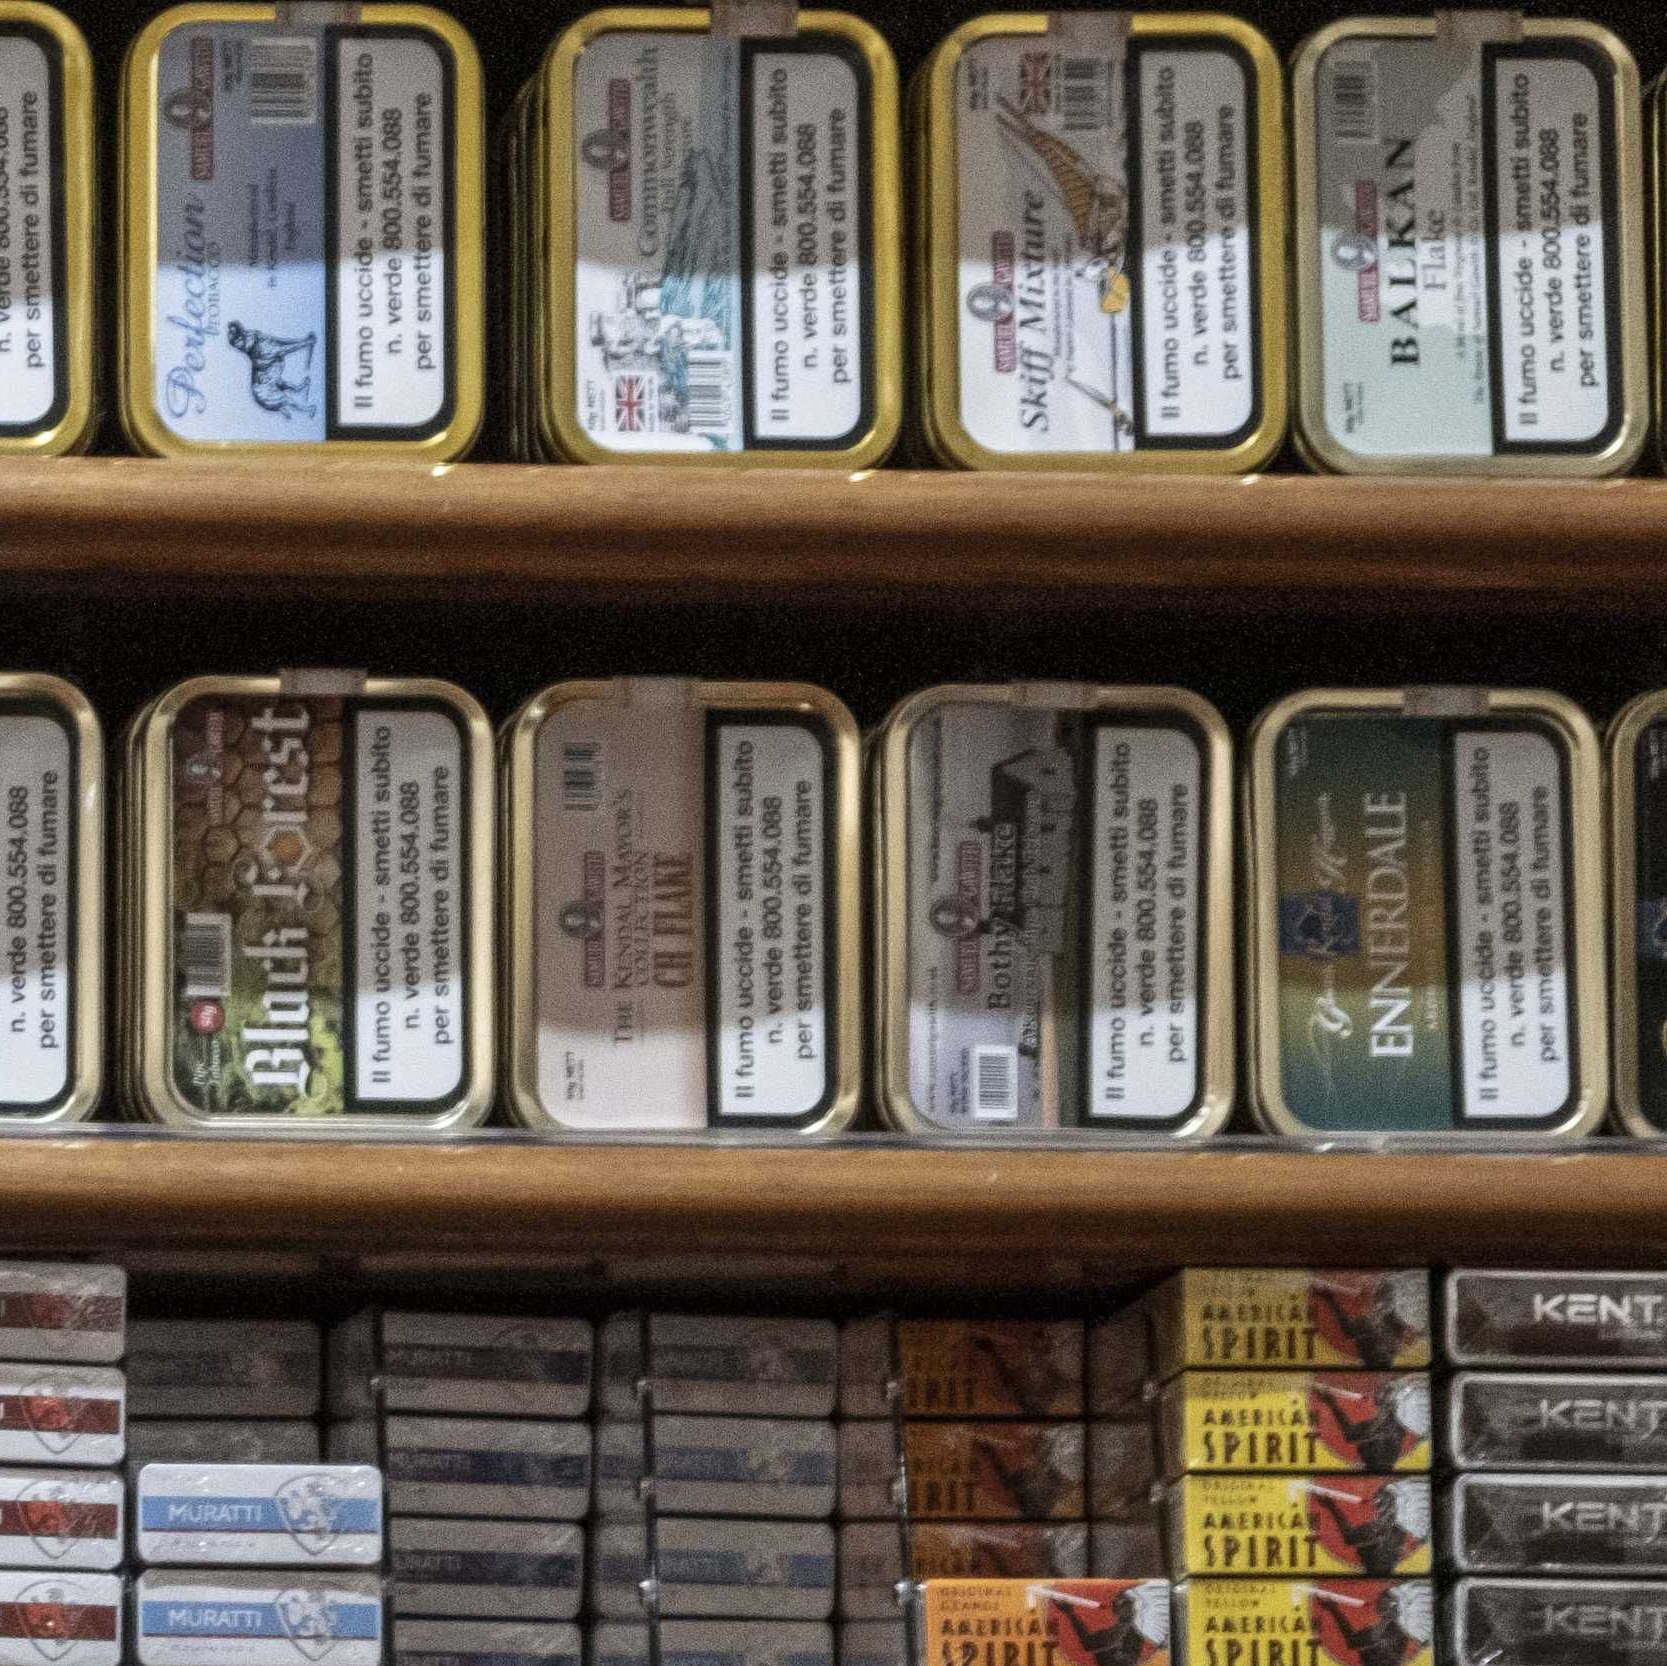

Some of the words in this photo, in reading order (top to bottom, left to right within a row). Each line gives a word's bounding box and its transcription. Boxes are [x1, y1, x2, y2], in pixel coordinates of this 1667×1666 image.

[1016, 189, 1049, 332] Mixture
[1389, 135, 1419, 369] BALKAN
[1421, 208, 1447, 292] Flake
[165, 197, 209, 419] Perfection
[1019, 341, 1056, 432] Skiff
[983, 821, 1017, 914] Flake
[983, 915, 1019, 1012] Bothy
[1363, 789, 1415, 1062] ENNERDALE
[1533, 1293, 1663, 1326] KENT
[167, 1502, 264, 1525] MURATTI
[1201, 1510, 1320, 1532] AMERICAN
[1201, 1534, 1321, 1570] SPIRIT
